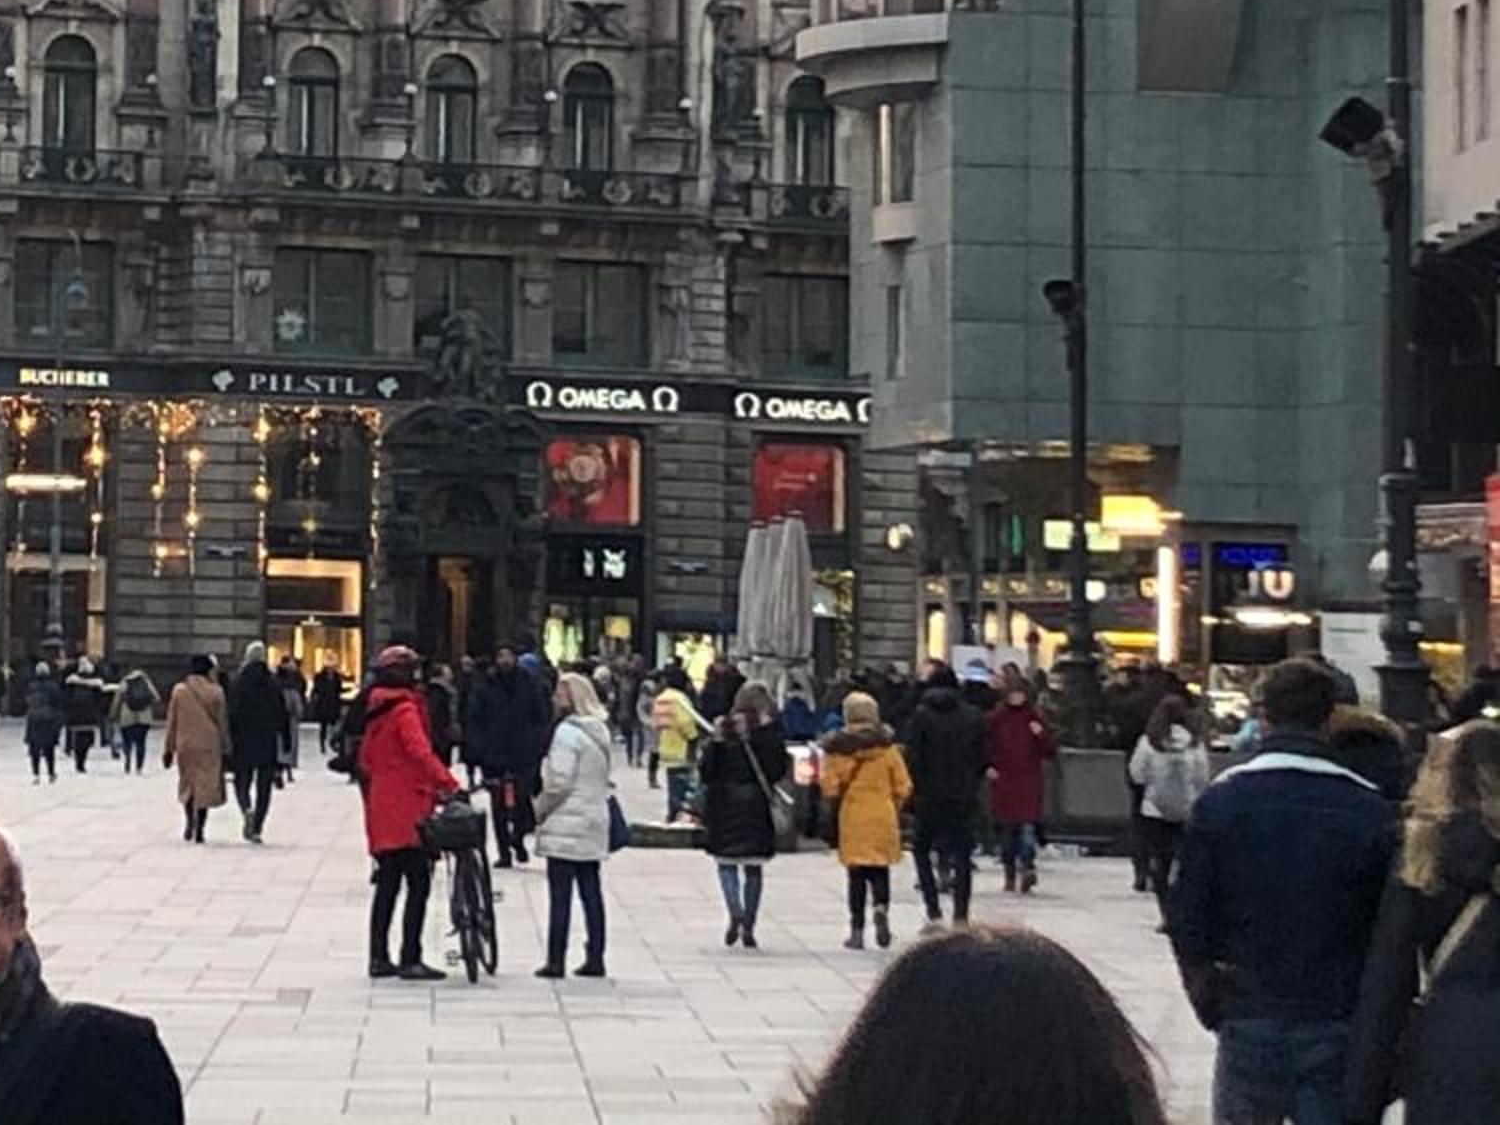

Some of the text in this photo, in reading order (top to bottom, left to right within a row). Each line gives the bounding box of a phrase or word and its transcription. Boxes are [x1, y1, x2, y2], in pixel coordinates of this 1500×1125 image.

[19, 368, 110, 387] BUCHERER
[558, 386, 647, 410] OMEGA
[765, 396, 851, 422] OMEGA
